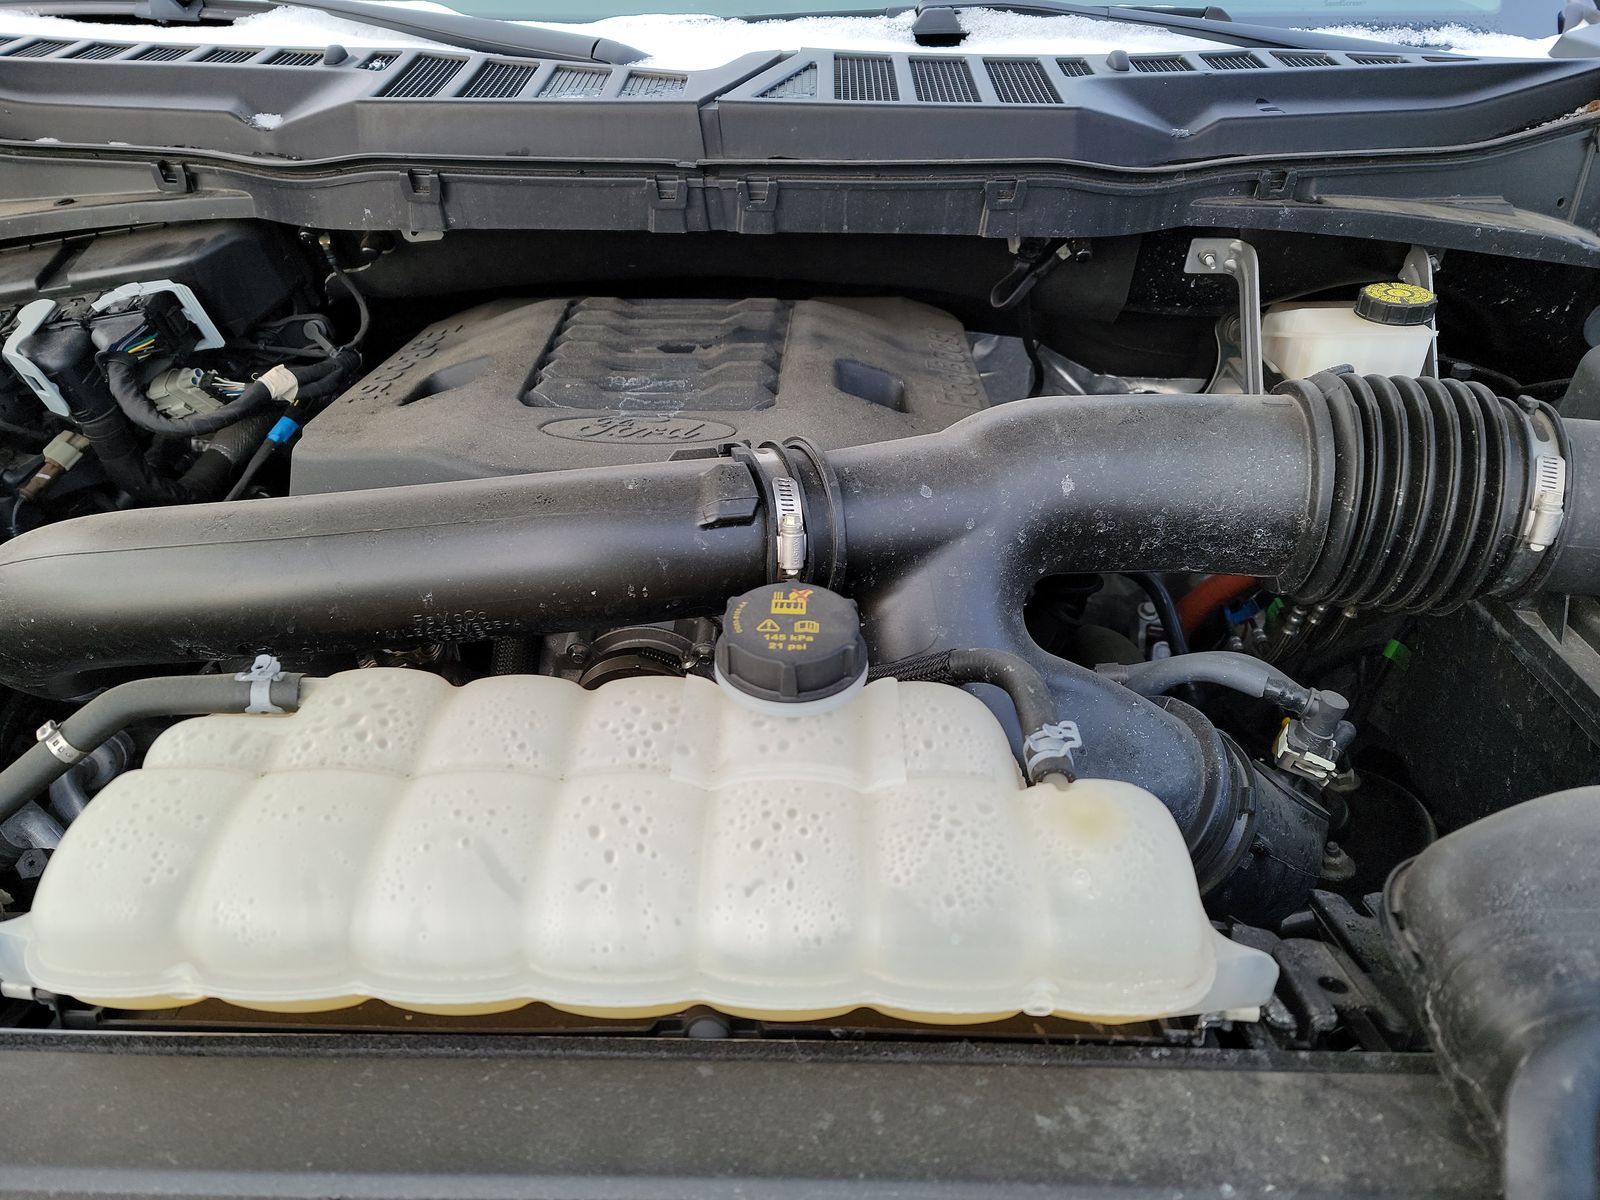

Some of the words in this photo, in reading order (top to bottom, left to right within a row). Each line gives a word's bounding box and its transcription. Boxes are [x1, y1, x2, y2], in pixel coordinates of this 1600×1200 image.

[577, 417, 705, 439] Ford
[763, 633, 787, 641] 145
[790, 633, 815, 642] kPa
[768, 642, 784, 650] 21
[787, 643, 807, 651] psi
